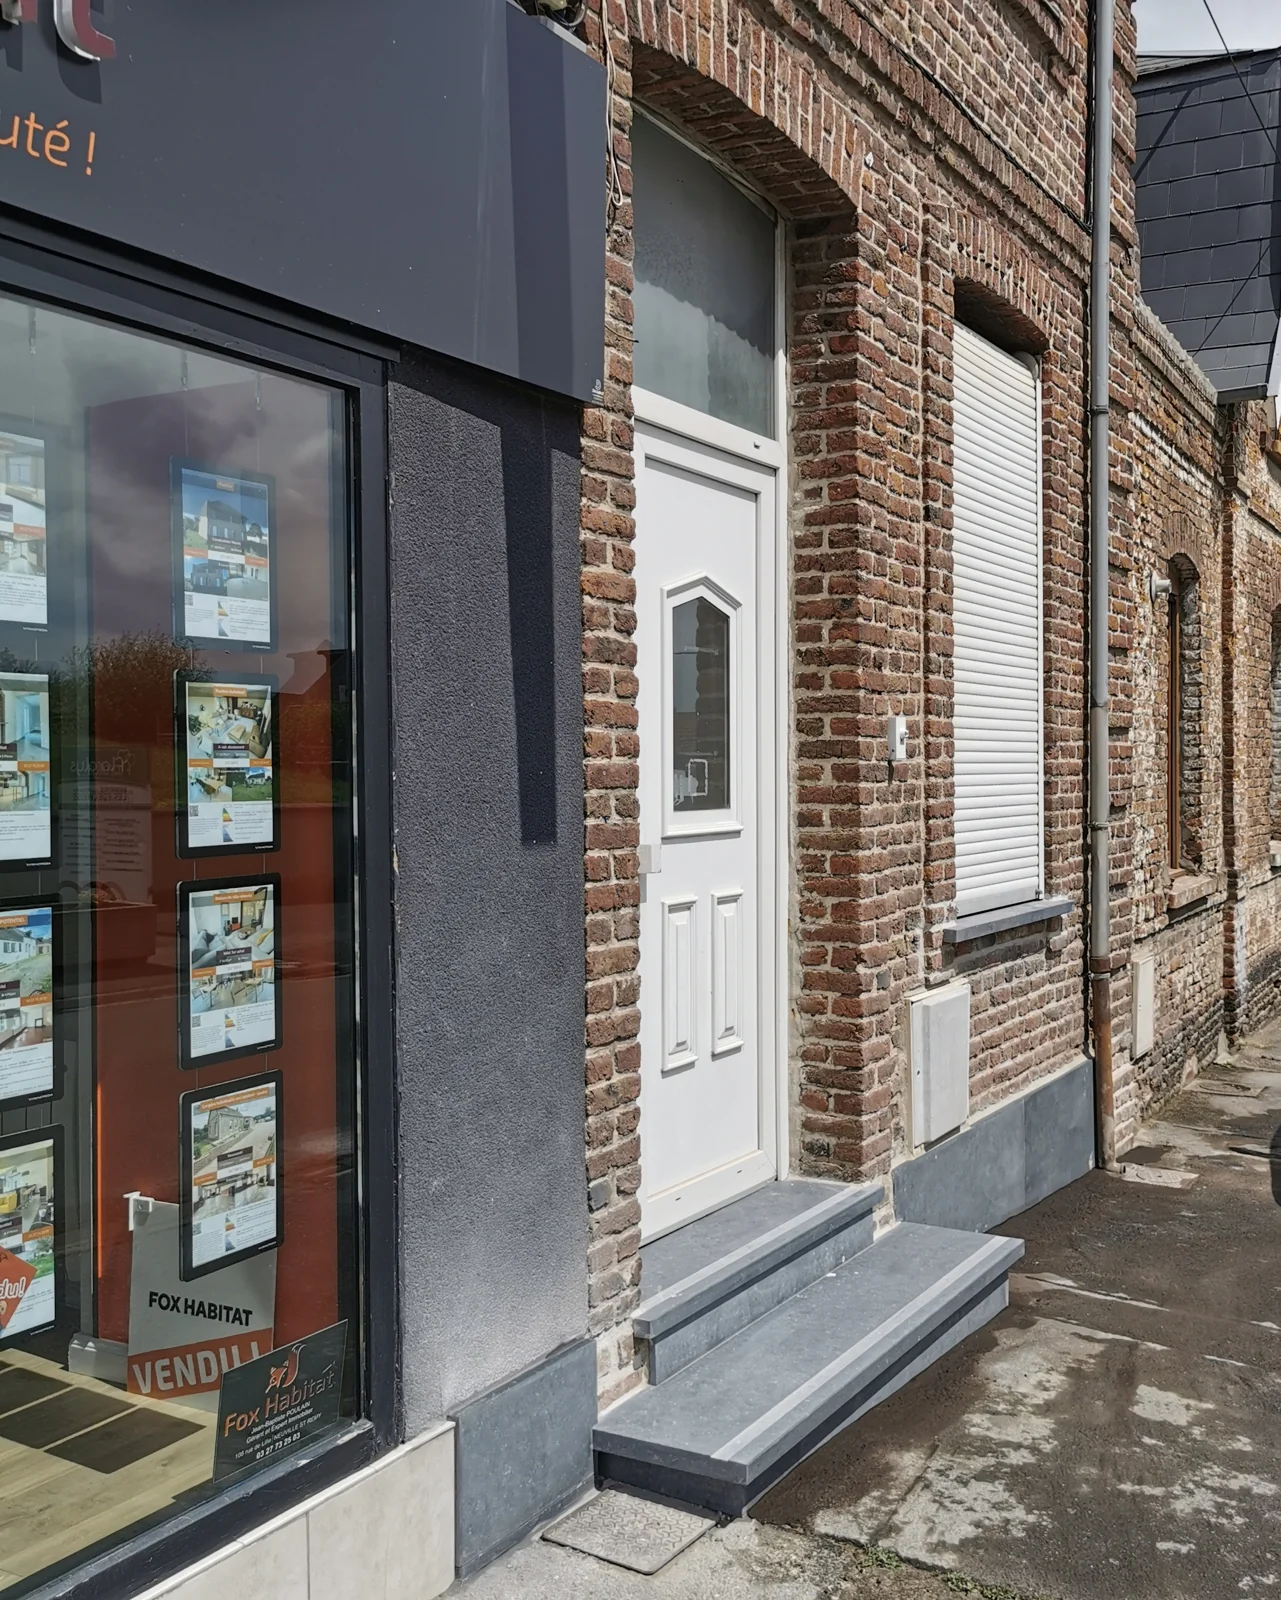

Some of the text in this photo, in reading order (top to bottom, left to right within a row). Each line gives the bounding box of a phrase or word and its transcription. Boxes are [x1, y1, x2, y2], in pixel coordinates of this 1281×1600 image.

[148, 1291, 253, 1327] FOX HABITAT
[224, 1371, 336, 1438] Fox Habitat
[286, 1400, 310, 1417] POULAIN
[271, 1420, 288, 1432] Expert
[274, 1423, 299, 1440] NEUVILLE
[256, 1450, 265, 1459] 03
[265, 1446, 274, 1455] 27
[275, 1440, 283, 1449] 73
[292, 1432, 301, 1441] 03
